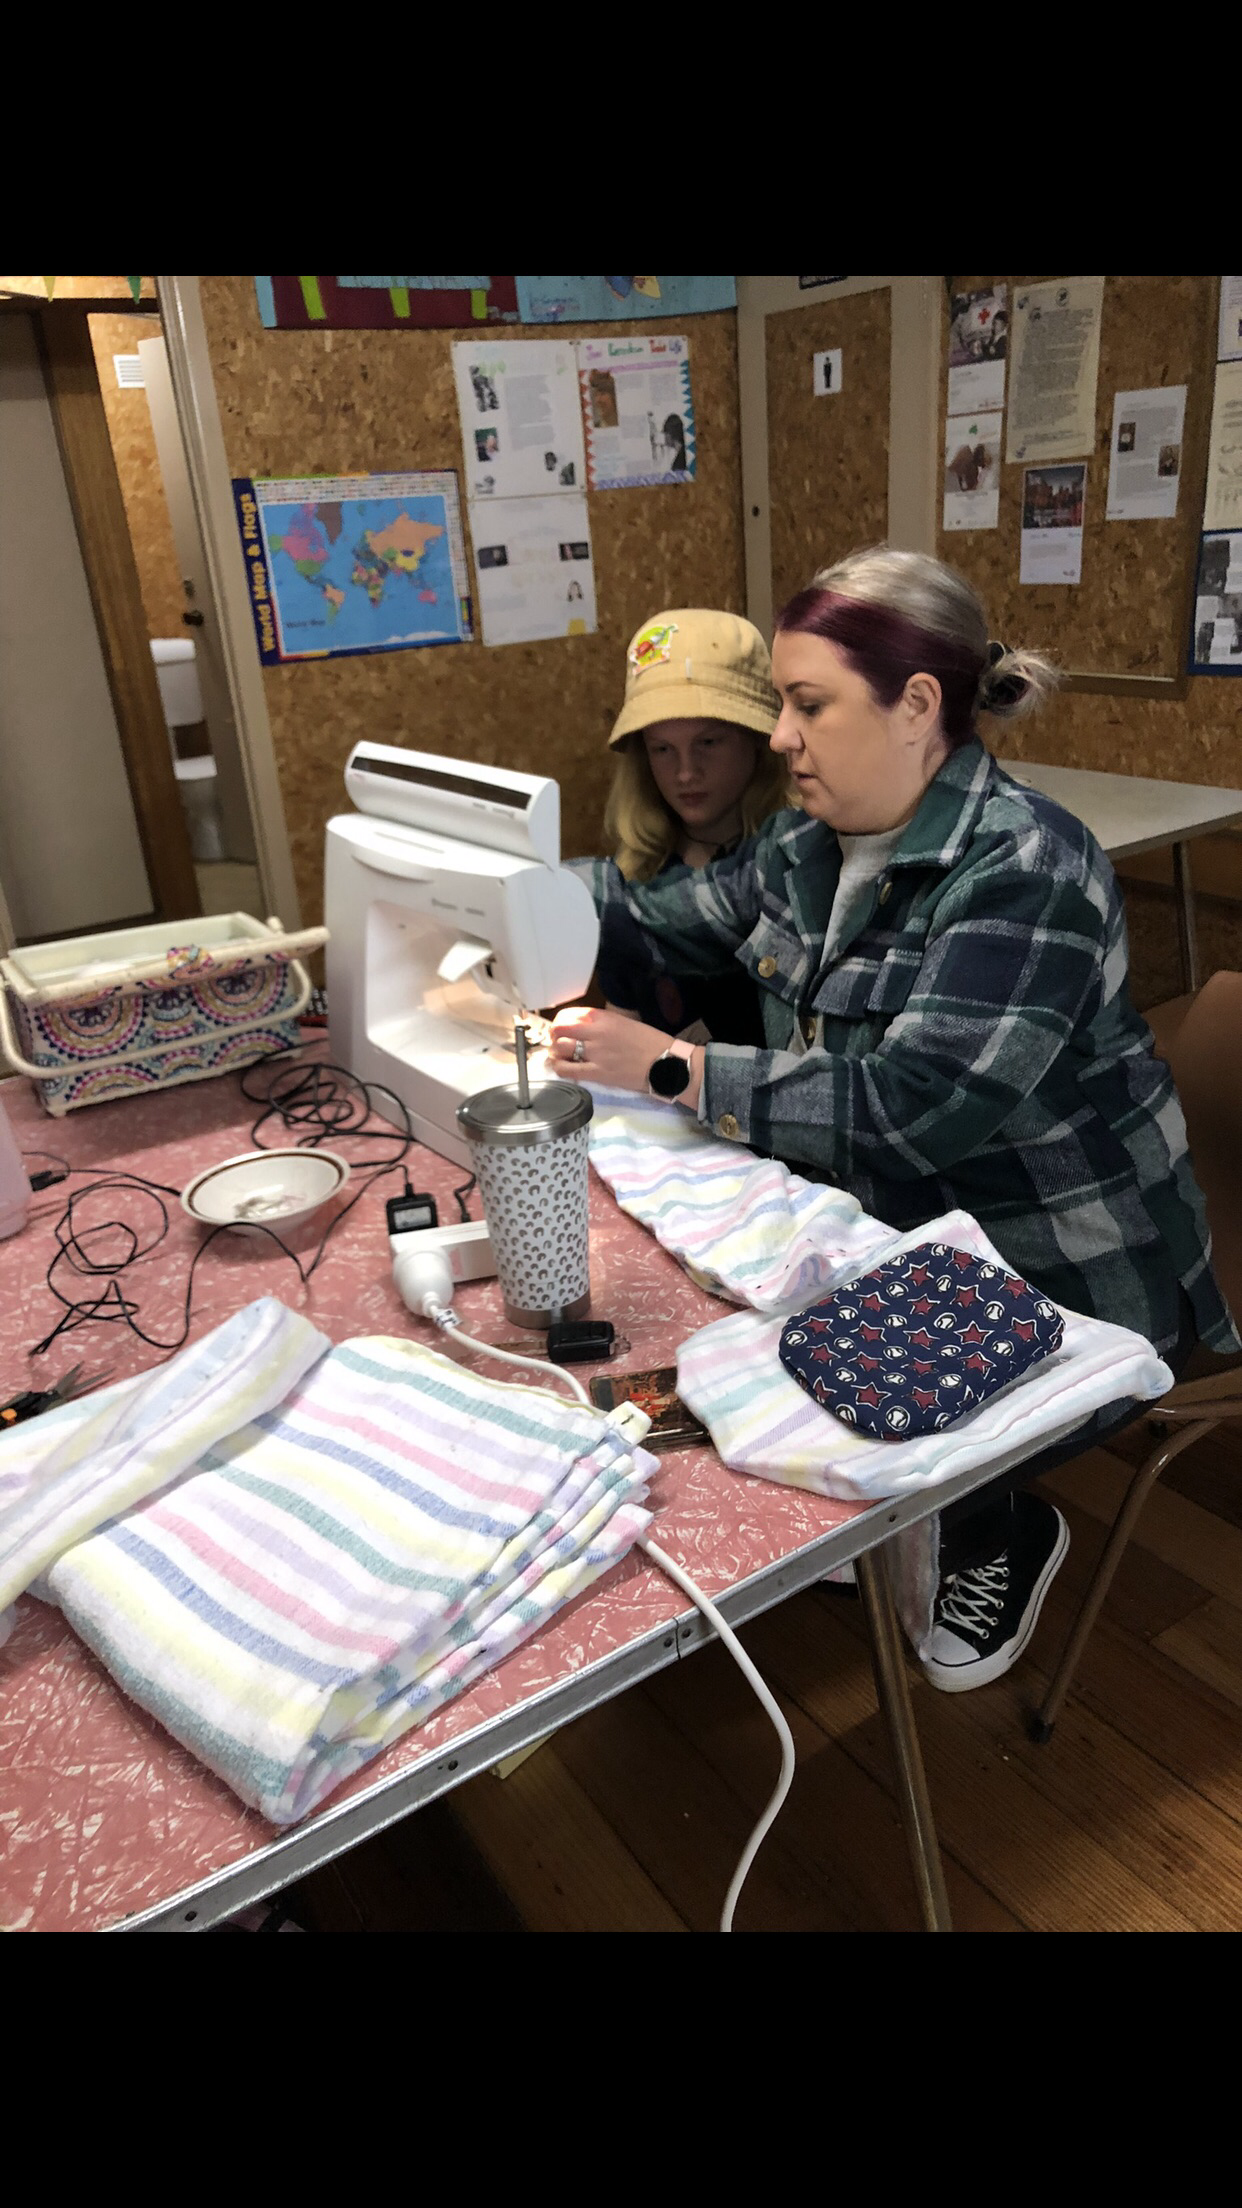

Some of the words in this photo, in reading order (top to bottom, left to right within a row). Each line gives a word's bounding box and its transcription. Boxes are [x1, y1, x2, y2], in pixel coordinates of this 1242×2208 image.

[239, 492, 257, 539] Flags
[246, 544, 261, 557] &
[251, 561, 268, 600] Map
[256, 603, 276, 653] World
